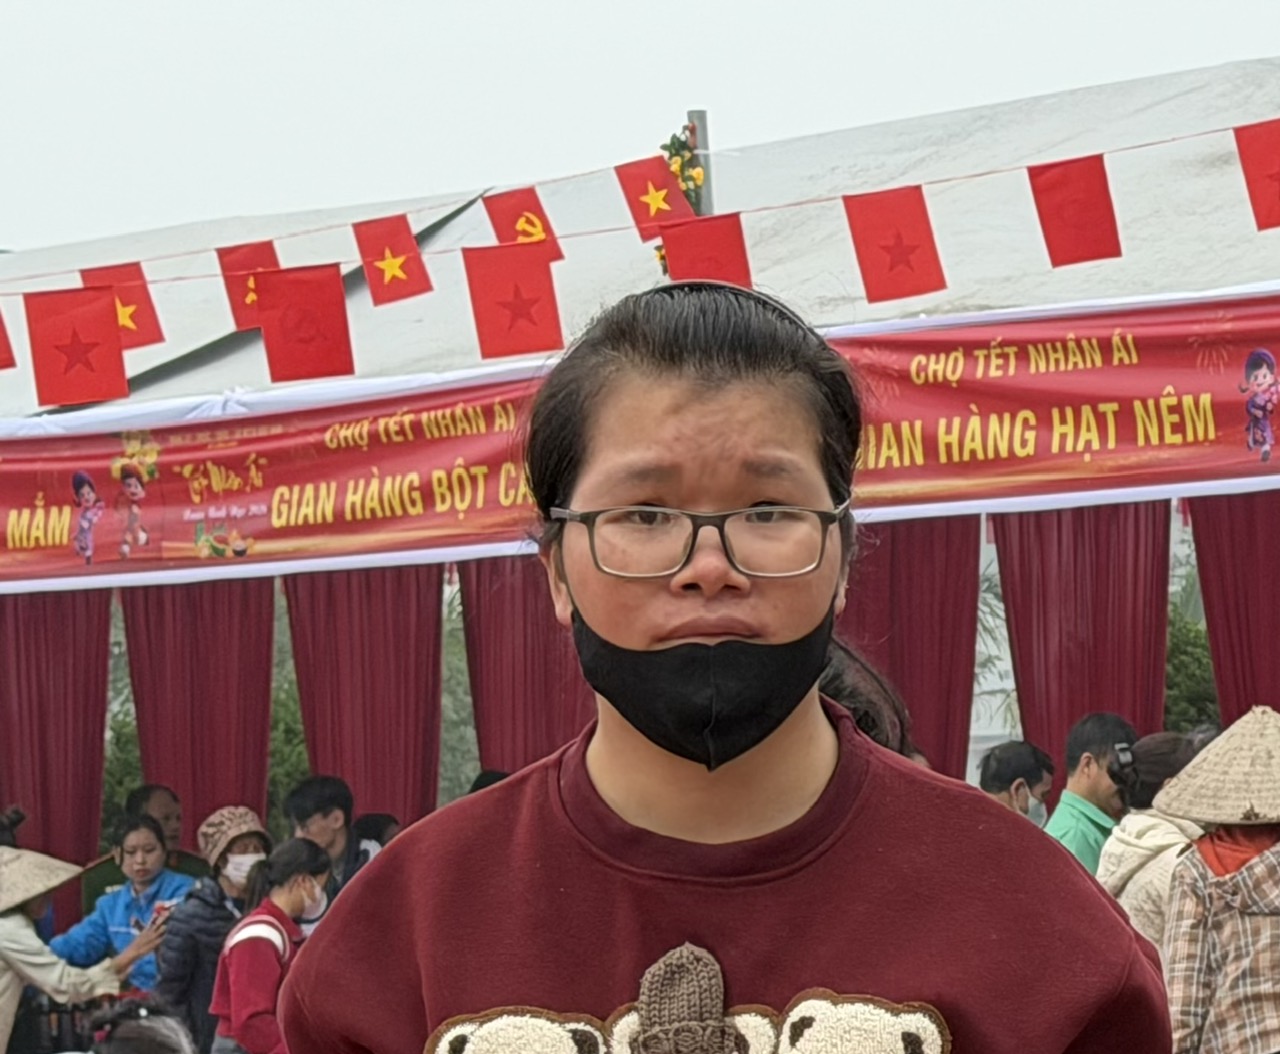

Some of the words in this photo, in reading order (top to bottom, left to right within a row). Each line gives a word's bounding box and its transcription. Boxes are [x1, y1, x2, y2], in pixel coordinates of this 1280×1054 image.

[910, 347, 965, 387] CHỢ
[974, 336, 1019, 379] TẾT
[1028, 332, 1102, 374] NHÂN
[1111, 328, 1139, 366] ÁI
[324, 417, 373, 451] CHỢ
[378, 407, 415, 443] TẾT
[421, 402, 487, 439] NHÂN
[853, 419, 925, 470] IAN
[937, 403, 1037, 464] HÀNG
[1051, 403, 1119, 463] HẠT
[1133, 385, 1216, 448] NÊM
[271, 481, 337, 528] GIAN
[345, 465, 424, 521] HÀNG
[432, 456, 489, 521] BỘT
